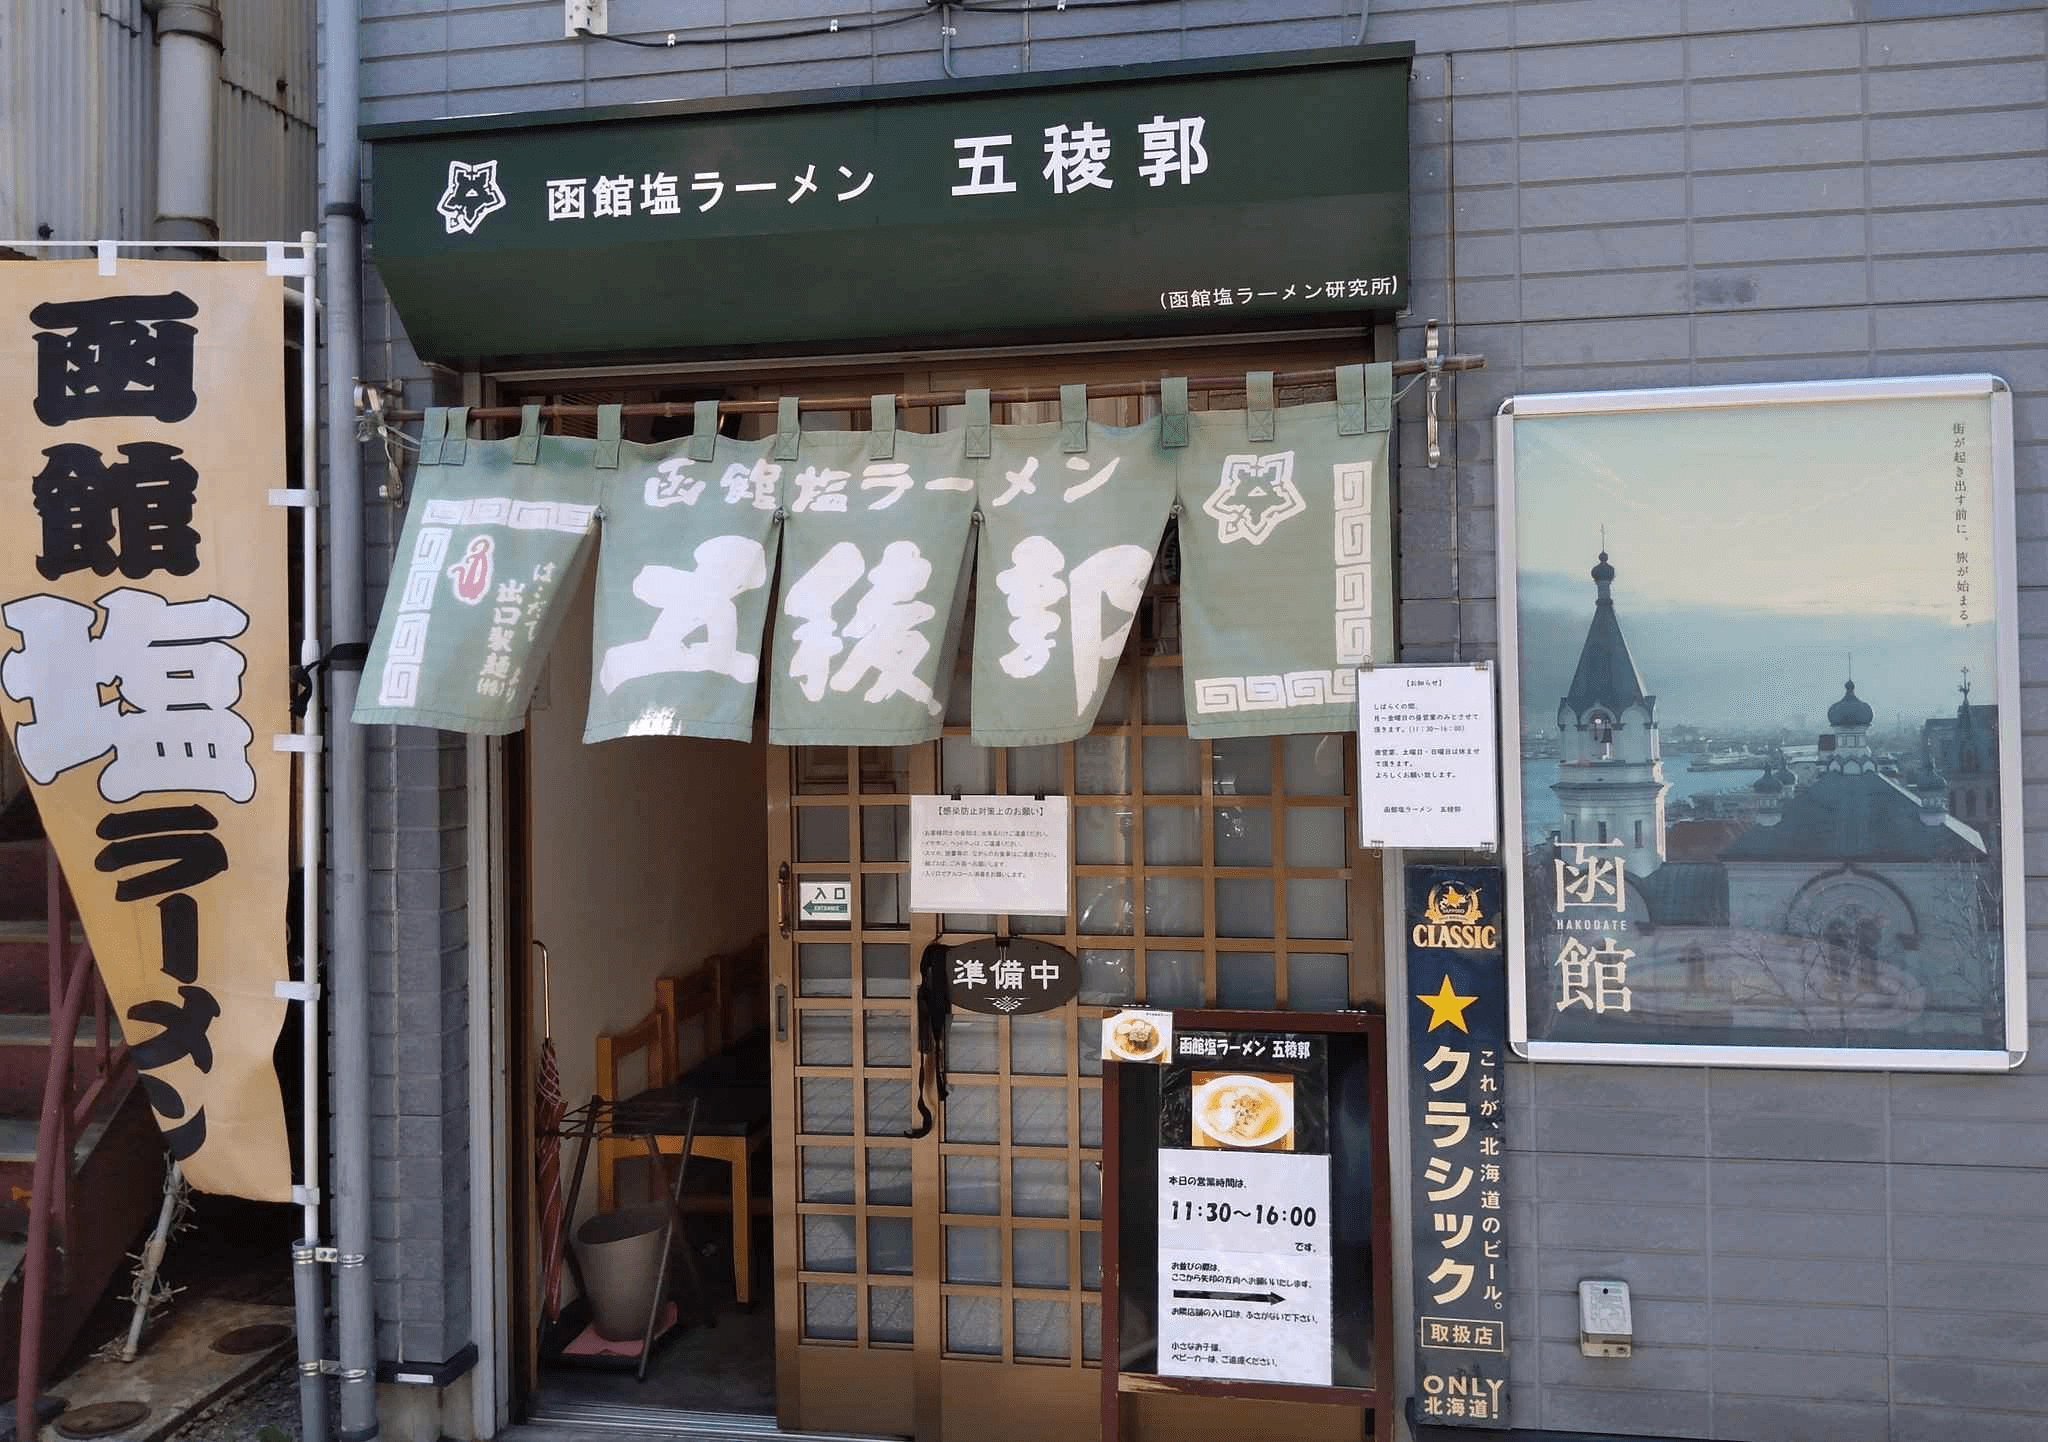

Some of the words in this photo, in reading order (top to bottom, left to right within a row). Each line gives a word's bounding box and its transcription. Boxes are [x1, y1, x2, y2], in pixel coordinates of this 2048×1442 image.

[547, 164, 875, 221] 函館塩ラーメン
[951, 115, 1209, 197] 五稜郭
[1160, 275, 1398, 311] (函館塩ラーメン研究所)
[644, 457, 1121, 511] 函館塩ラーメン
[600, 535, 1154, 717] 五稜郭
[815, 888, 846, 900] 入口
[1413, 924, 1497, 949] CLASSIC
[1557, 919, 1627, 931] HAKODATE
[952, 959, 1060, 990] 準備中
[1180, 1036, 1266, 1057] 函館塩ラーメン
[1272, 1039, 1311, 1060] 五稜郭
[1424, 1046, 1474, 1305] クラシック
[1479, 1050, 1503, 1310] これが、北海道のビール。
[1430, 1323, 1493, 1345] 取扱店
[1423, 1375, 1504, 1399] ONLY
